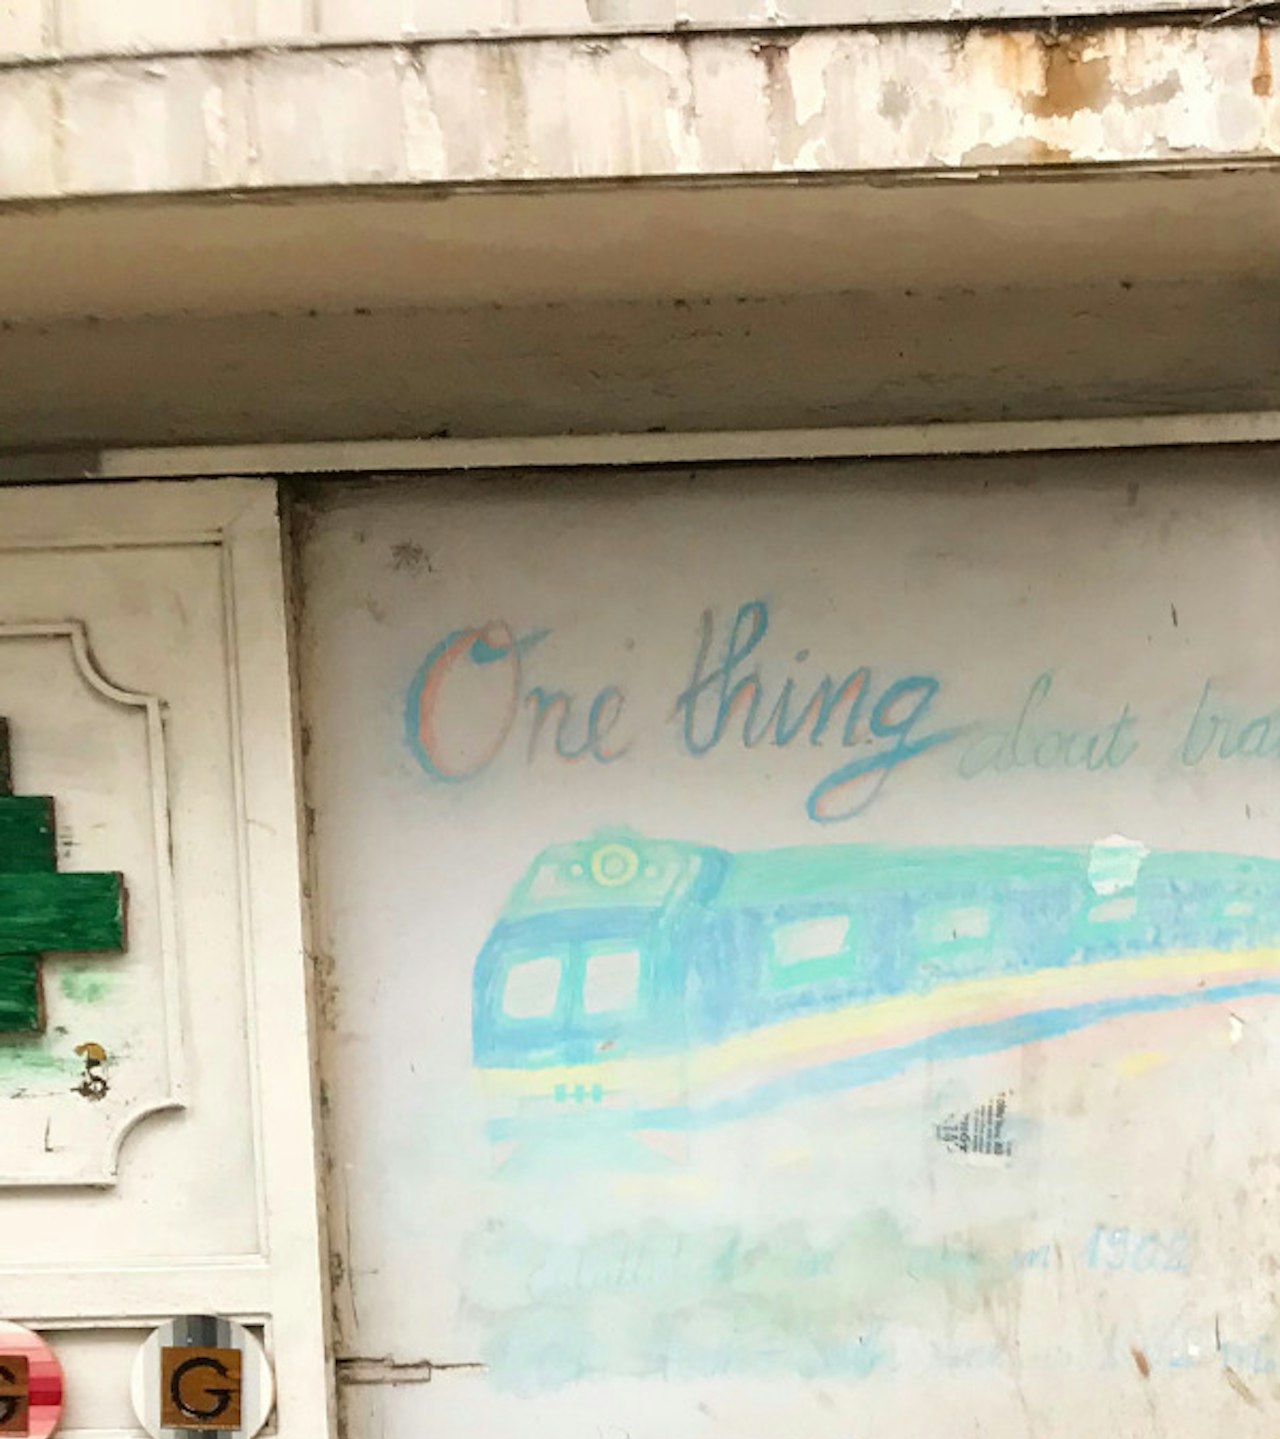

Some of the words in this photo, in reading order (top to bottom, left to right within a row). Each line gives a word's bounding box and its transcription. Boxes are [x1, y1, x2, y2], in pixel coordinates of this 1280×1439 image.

[403, 618, 632, 783] One
[666, 599, 966, 823] thing
[170, 1356, 238, 1420] G
